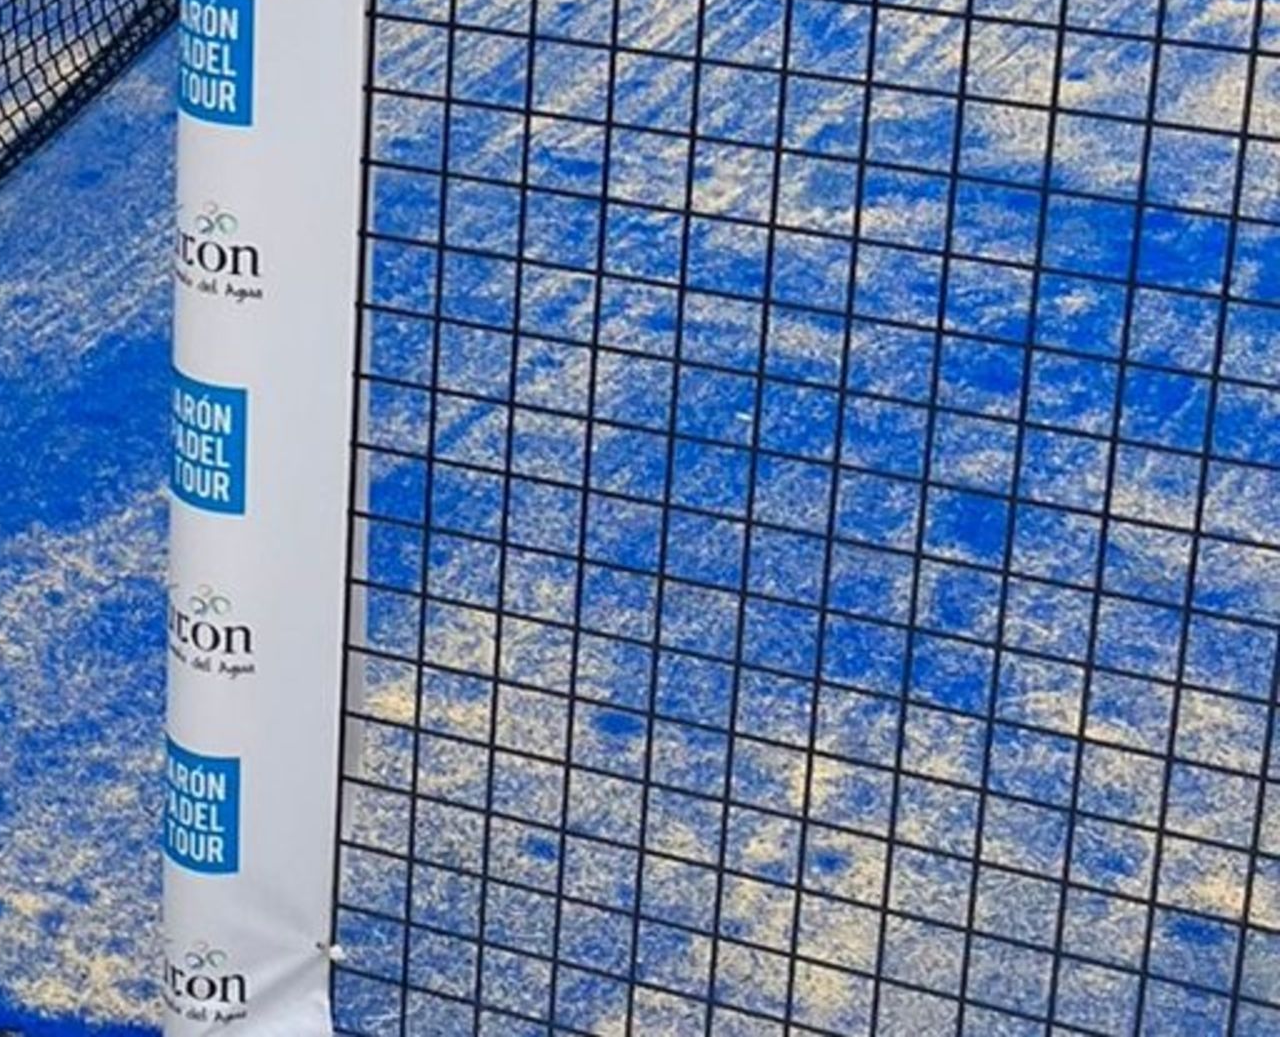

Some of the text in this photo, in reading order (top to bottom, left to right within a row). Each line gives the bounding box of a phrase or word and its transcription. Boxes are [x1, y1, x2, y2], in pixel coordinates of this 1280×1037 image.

[179, 26, 237, 77] ADEL
[171, 416, 231, 469] ADEL
[164, 780, 226, 833] ADEL
